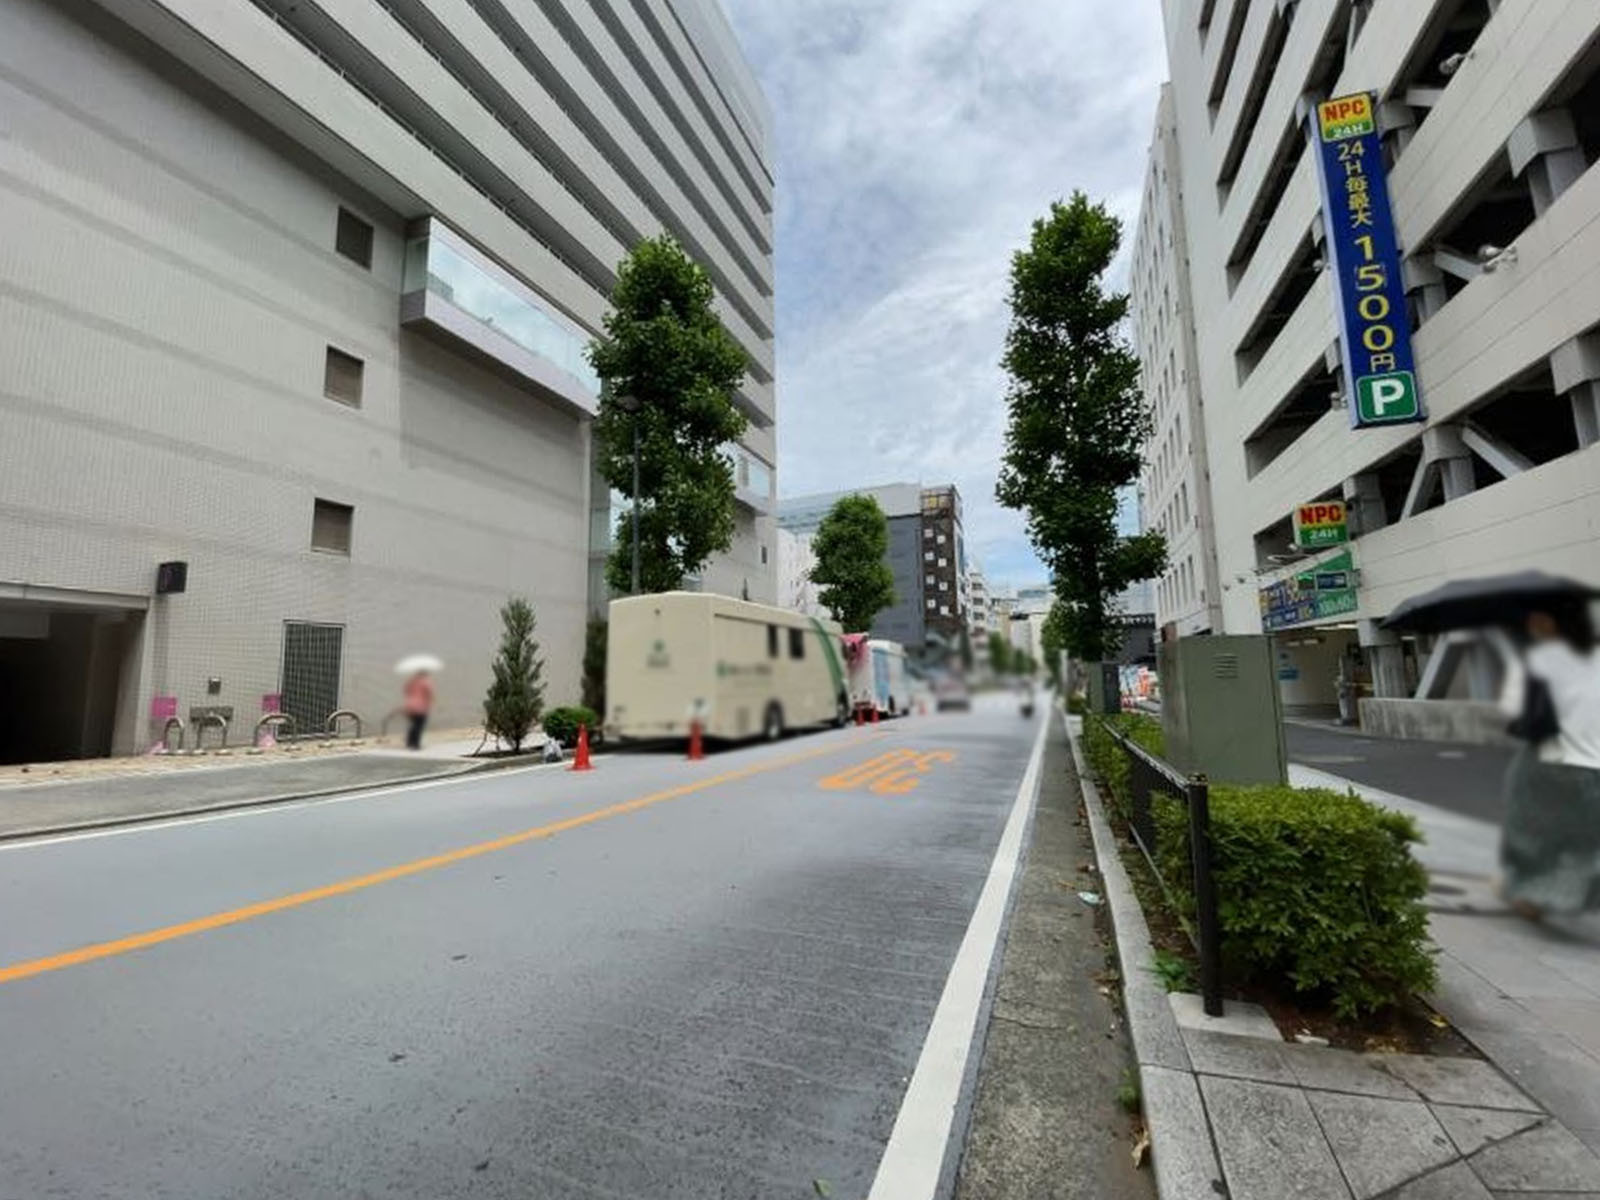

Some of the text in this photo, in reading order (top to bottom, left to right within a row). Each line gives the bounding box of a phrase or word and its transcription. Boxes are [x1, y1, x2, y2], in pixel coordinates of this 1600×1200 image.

[1325, 100, 1365, 121] NPC
[1370, 378, 1405, 415] P
[1300, 505, 1341, 525] NPC
